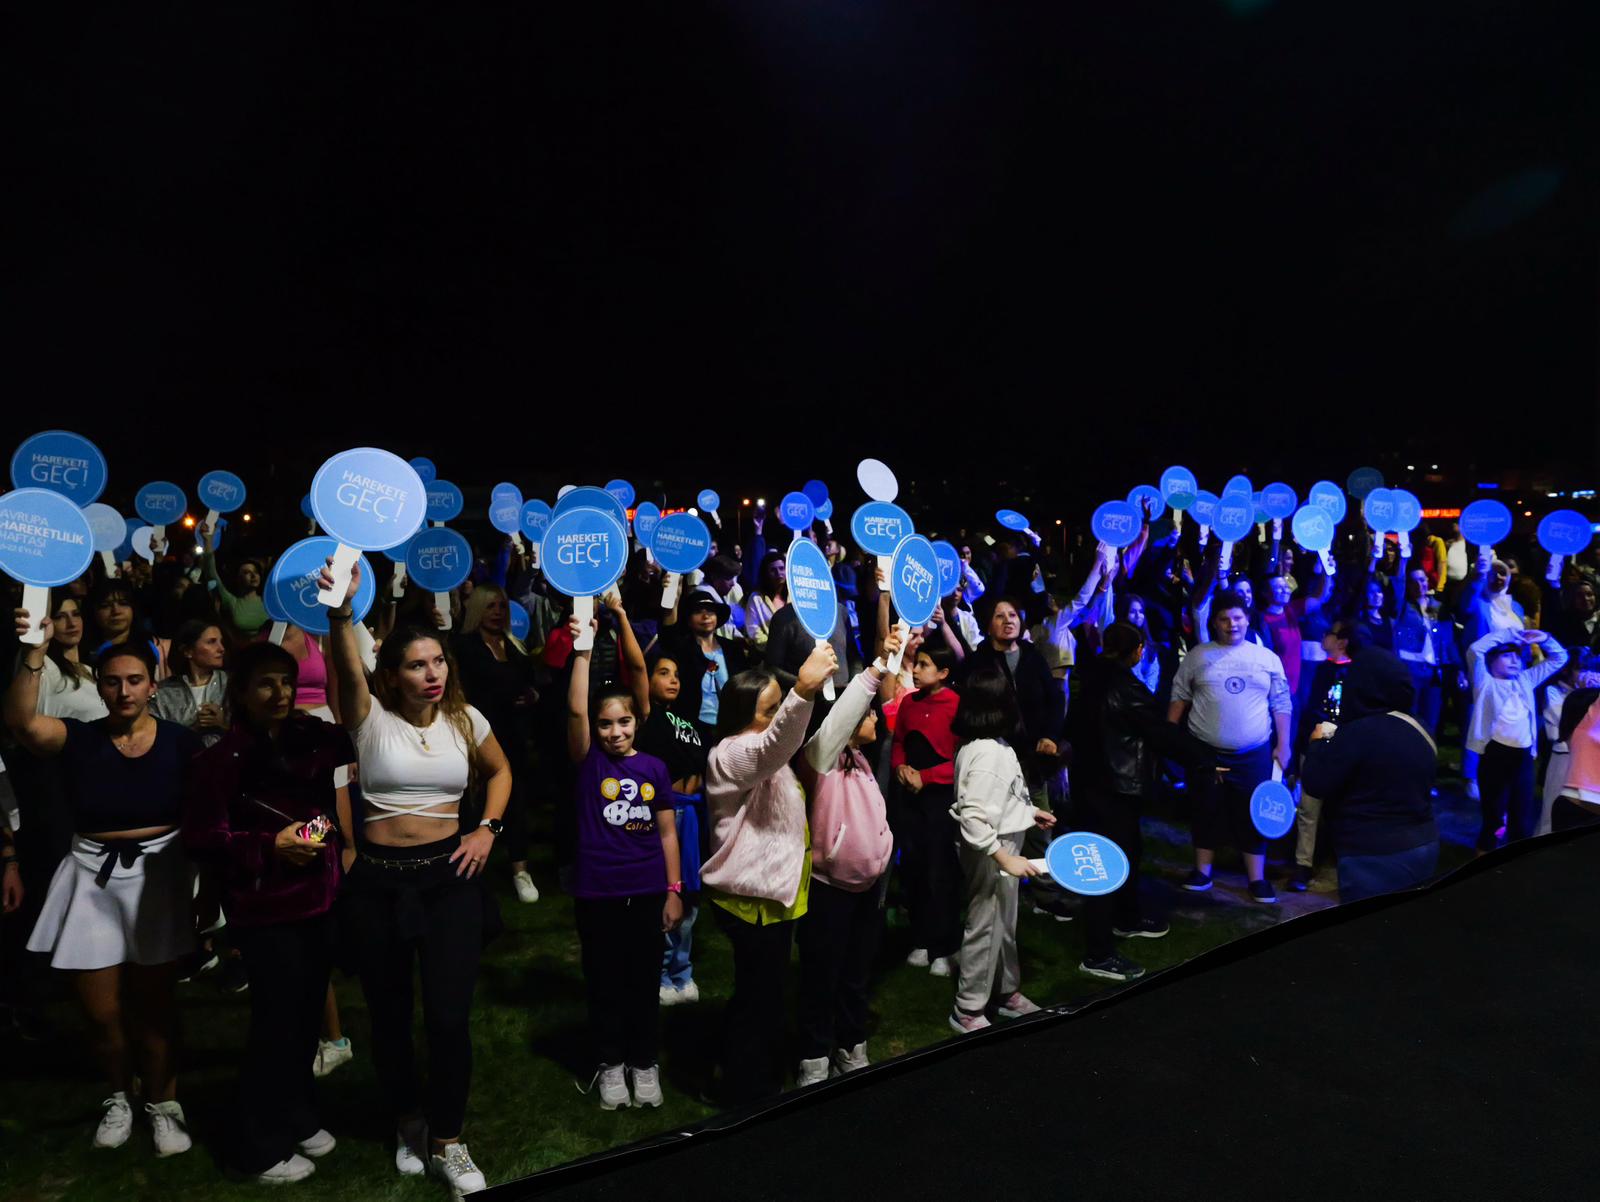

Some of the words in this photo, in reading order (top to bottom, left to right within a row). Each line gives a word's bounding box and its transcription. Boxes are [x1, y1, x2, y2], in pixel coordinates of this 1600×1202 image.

[32, 453, 89, 468] HAREKETE
[31, 463, 88, 489] GEÇ!
[342, 469, 408, 502] HAREKETE
[337, 483, 405, 523] GEÇ!
[557, 532, 609, 544] HAREKETE
[864, 521, 902, 540] GEÇ!
[419, 552, 459, 571] GEÇ!
[557, 542, 609, 568] GEÇ!
[905, 553, 934, 584] HAREKETE
[901, 564, 932, 603] GEÇ!
[1071, 844, 1099, 882] GEÇ!
